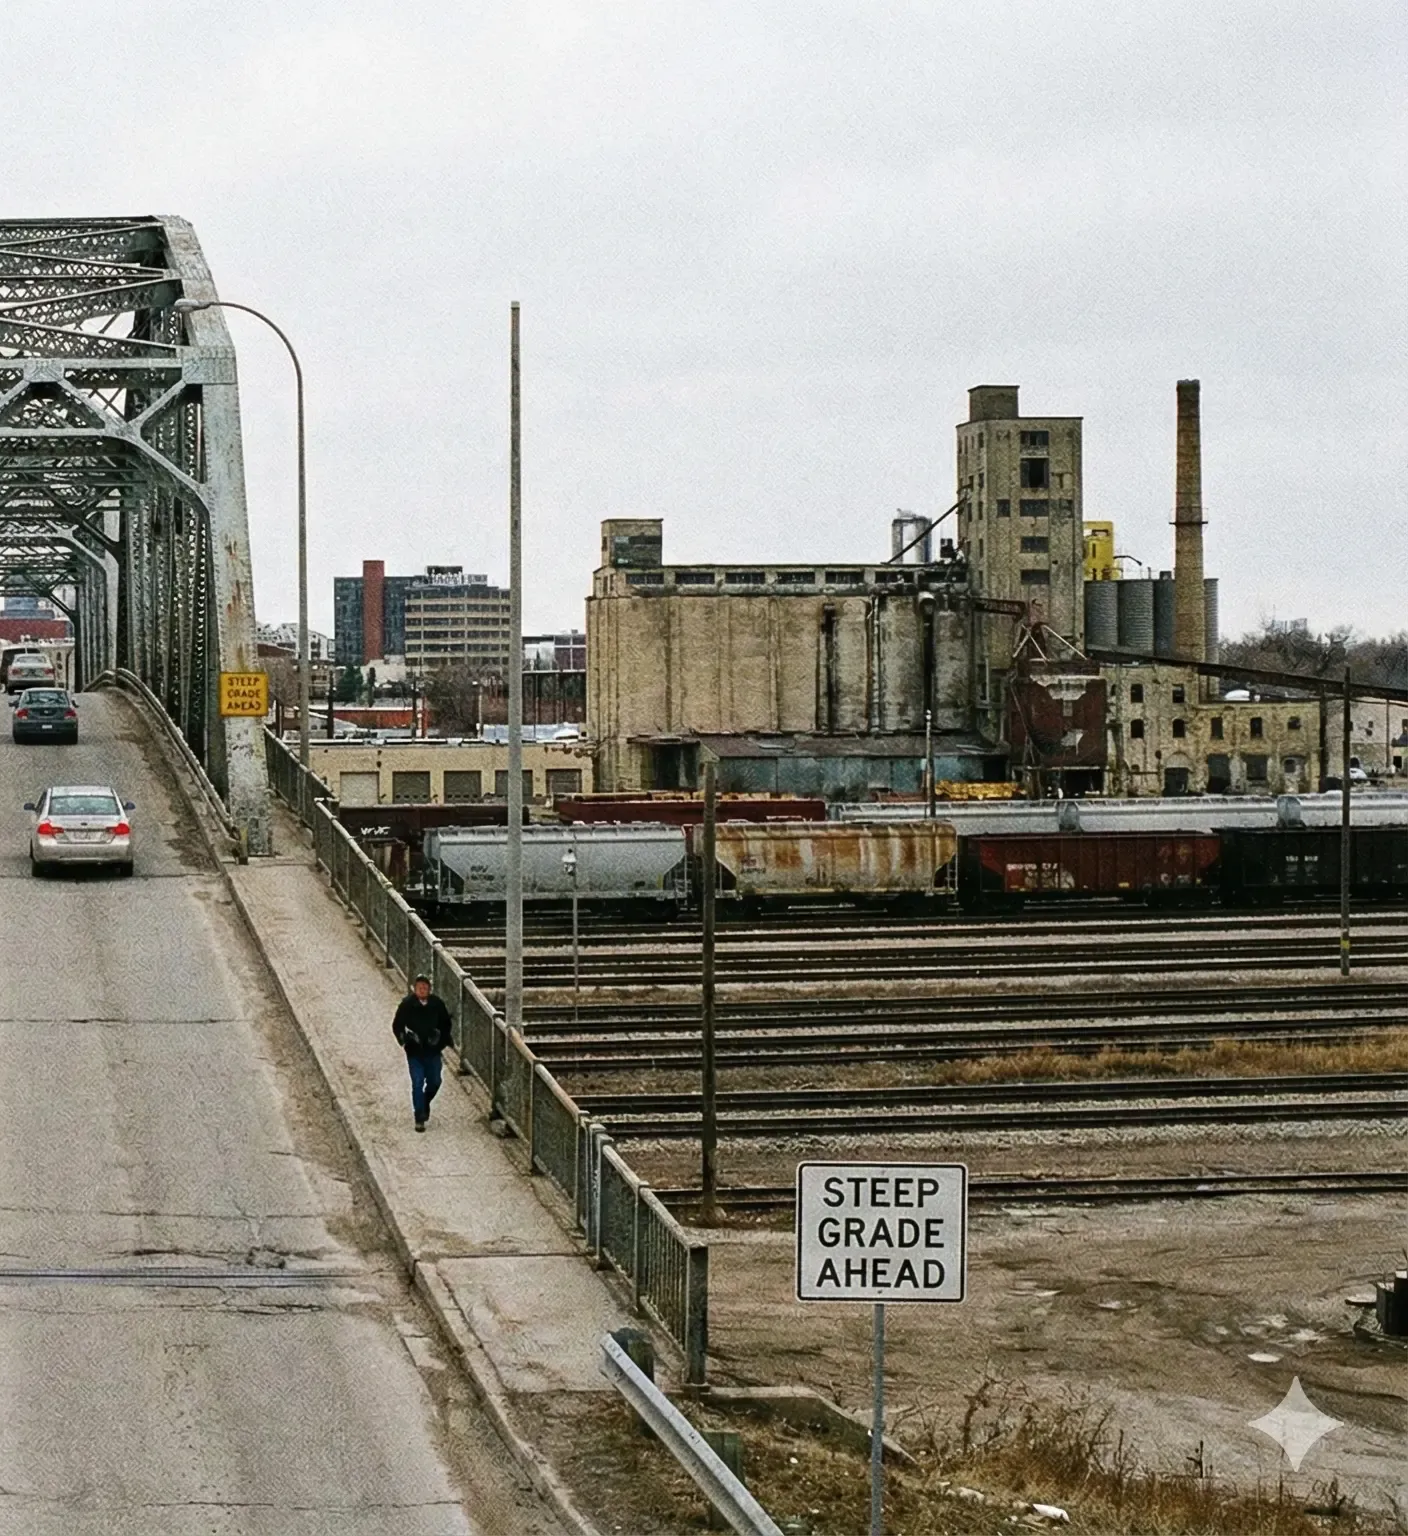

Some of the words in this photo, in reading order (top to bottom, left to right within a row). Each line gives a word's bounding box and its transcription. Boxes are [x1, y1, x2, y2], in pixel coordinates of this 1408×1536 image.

[227, 676, 260, 687] STEEP
[227, 689, 261, 699] GRADE
[226, 701, 262, 711] AHEAD
[822, 1176, 940, 1209] STEEP
[817, 1217, 945, 1249] GRADE
[815, 1257, 946, 1289] AHEAD
